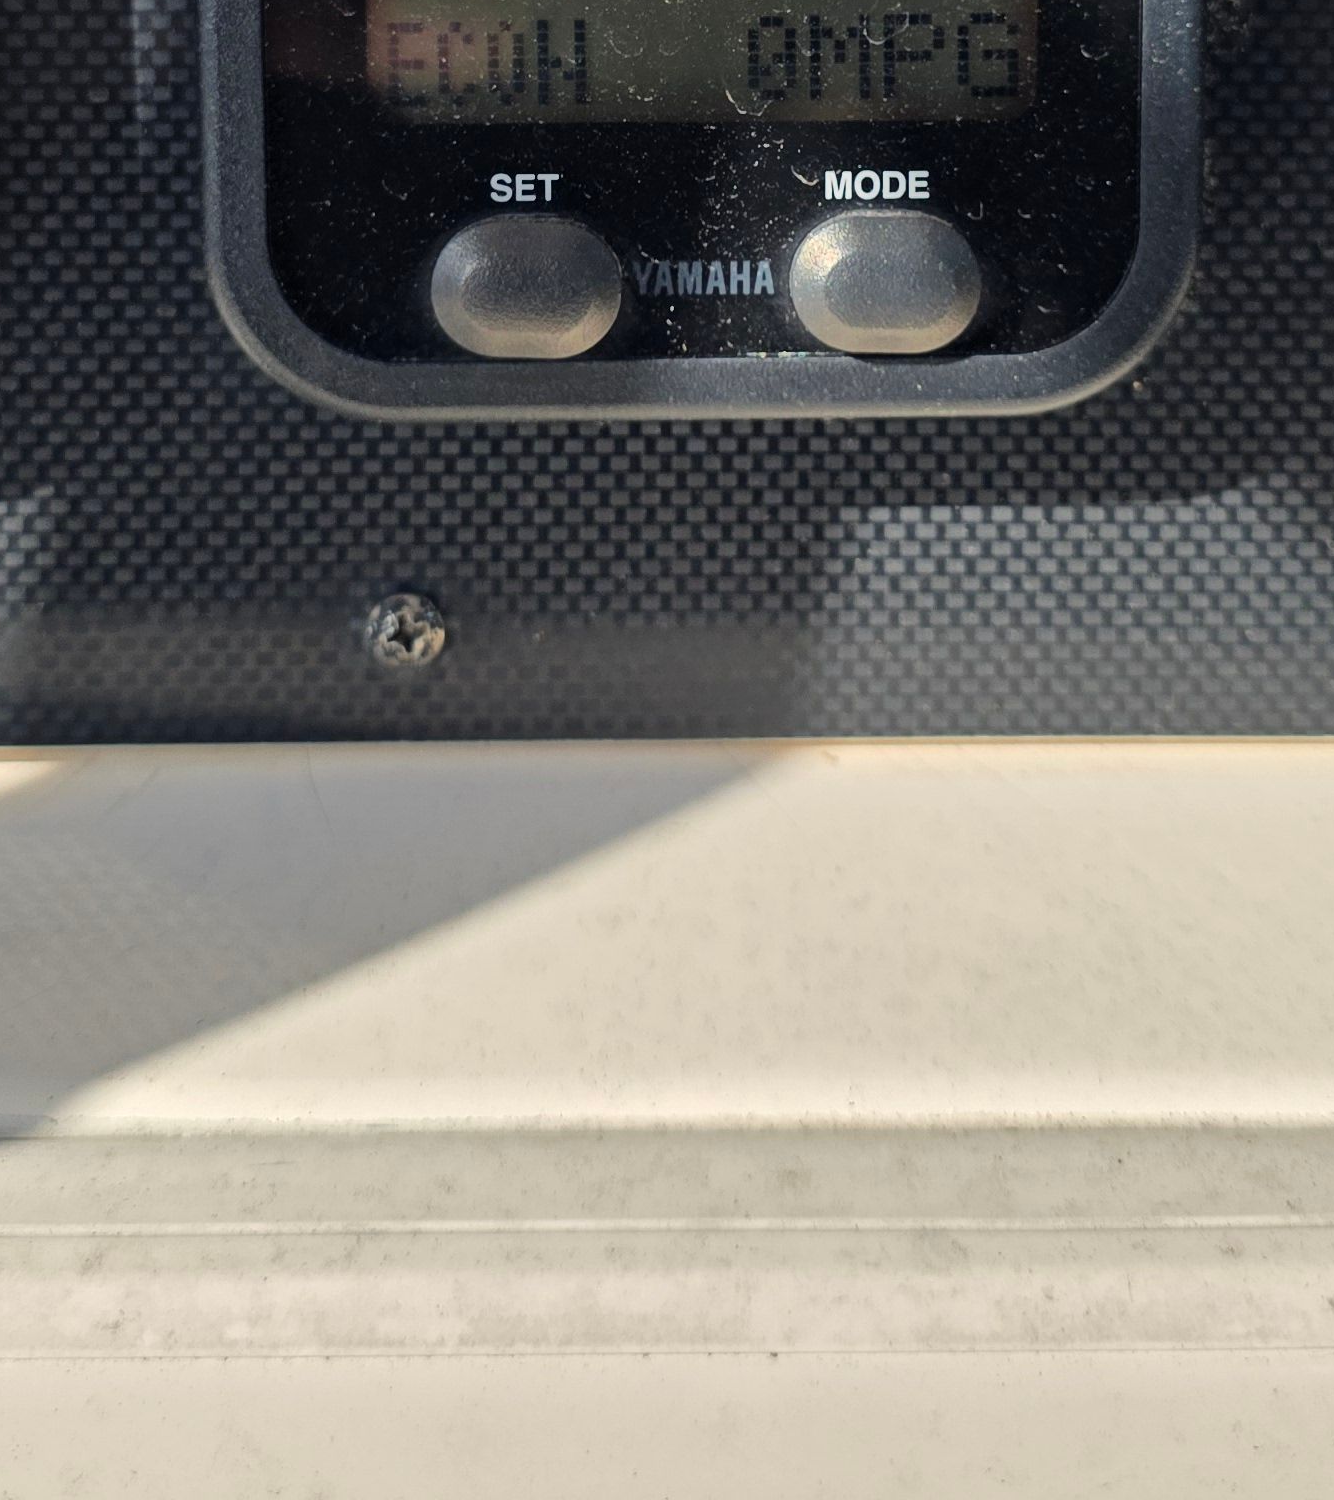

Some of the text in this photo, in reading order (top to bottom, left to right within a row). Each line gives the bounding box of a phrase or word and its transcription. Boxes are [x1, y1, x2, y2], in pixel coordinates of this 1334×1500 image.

[490, 173, 560, 202] SET
[824, 170, 931, 200] MODE
[633, 260, 775, 296] YAMAHA
